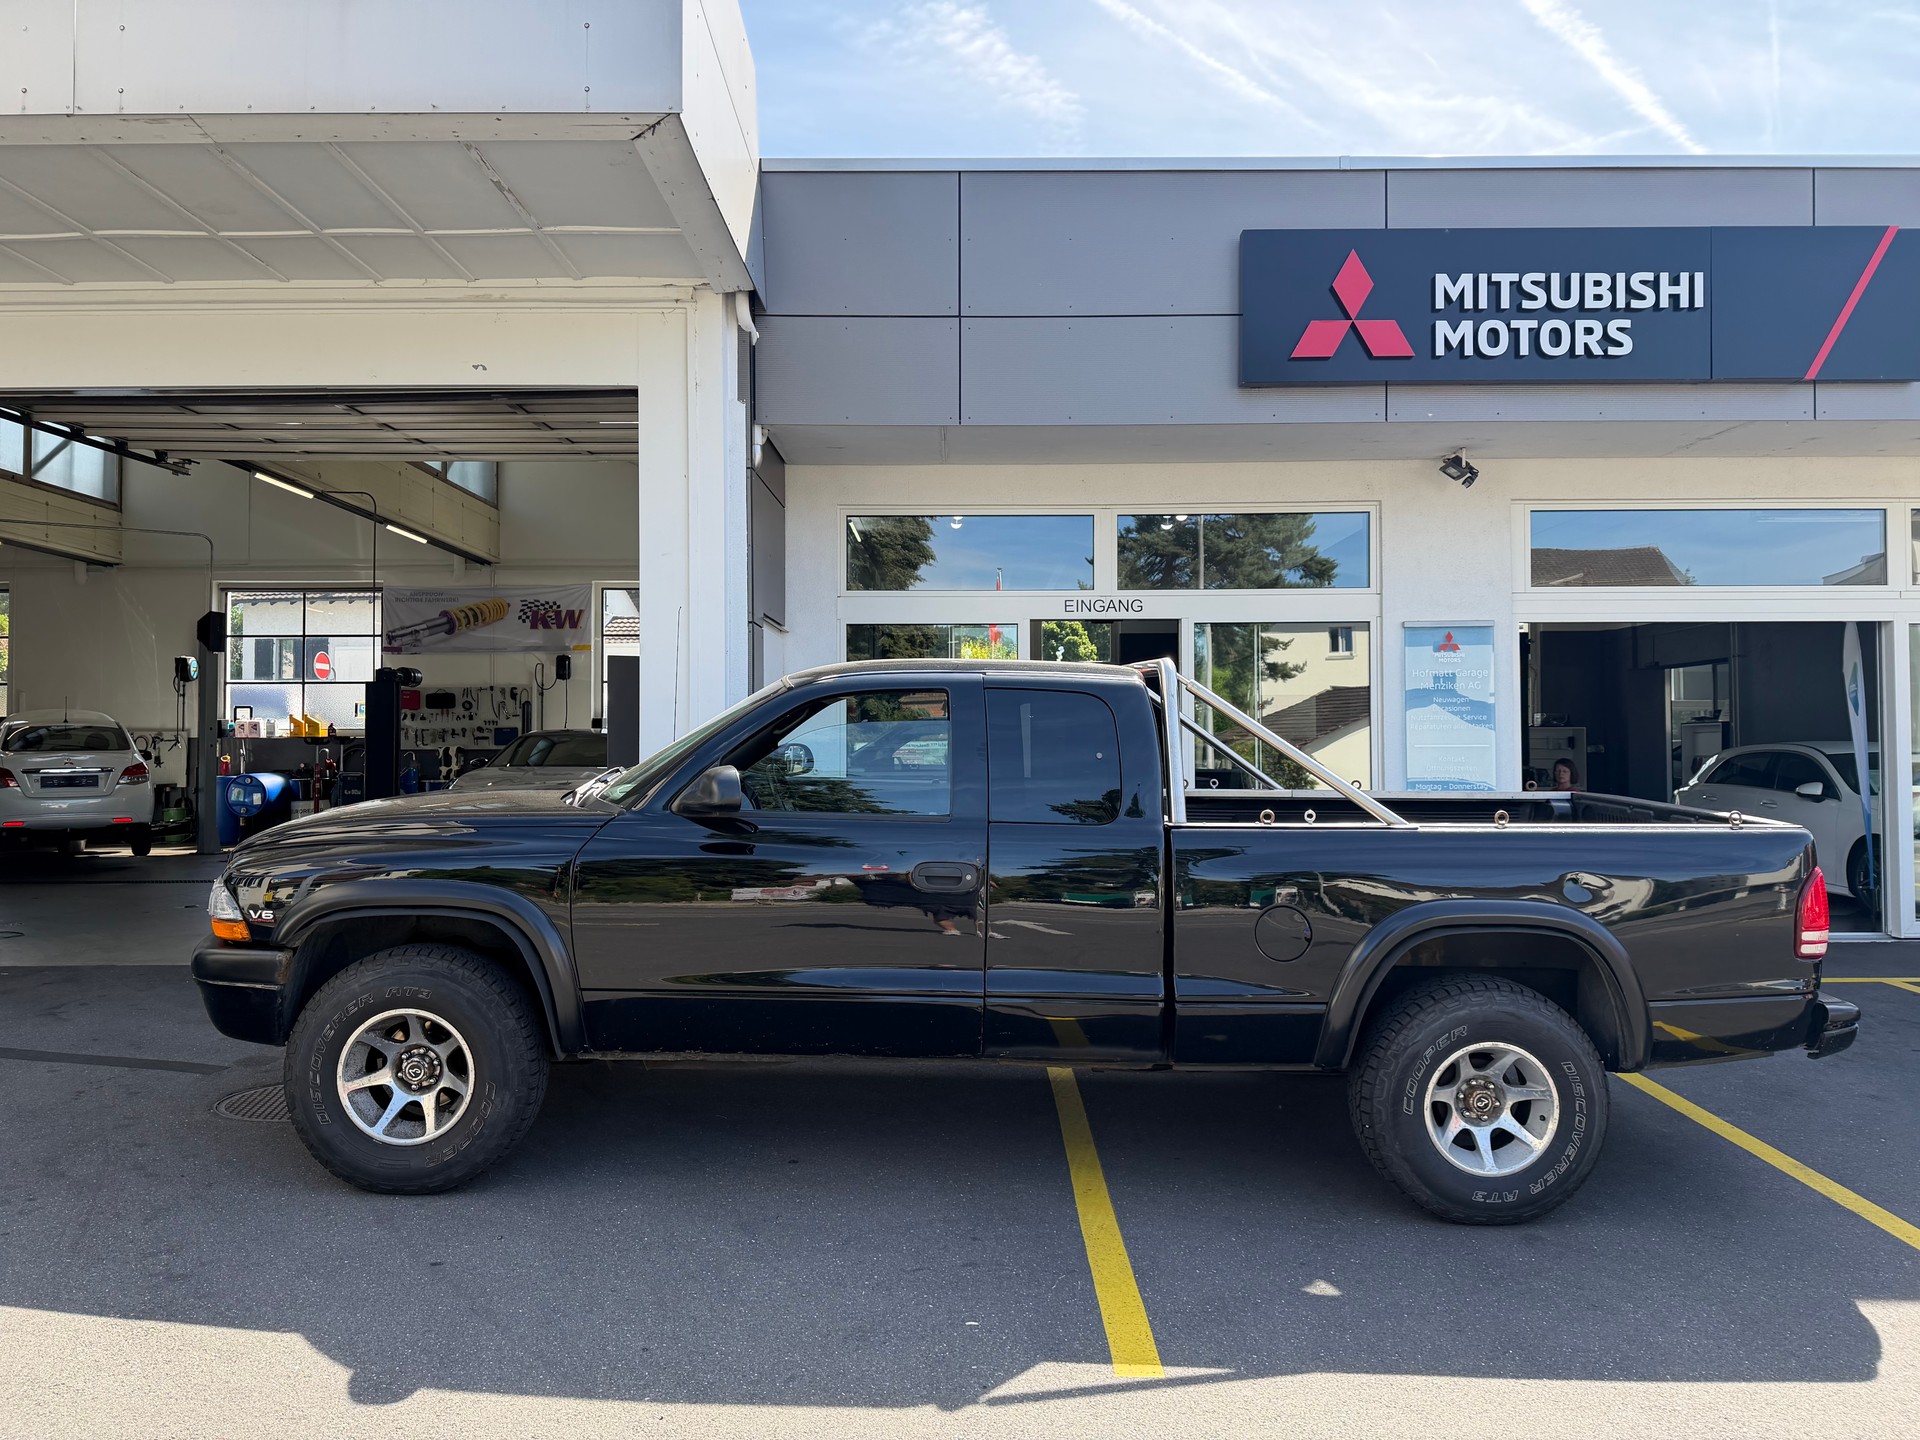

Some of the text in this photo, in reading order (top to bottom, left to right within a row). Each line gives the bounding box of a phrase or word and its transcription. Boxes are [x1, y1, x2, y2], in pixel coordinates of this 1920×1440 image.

[1434, 271, 1704, 310] MITSUBISHI
[1434, 318, 1634, 358] MOTORS
[1064, 599, 1144, 613] EINGANG
[529, 608, 585, 631] KW
[1412, 668, 1488, 679] Hofmatt Garage
[1420, 681, 1482, 690] Menziken AG
[1433, 696, 1469, 705] Neuwagen
[1463, 713, 1488, 721] Service
[1415, 783, 1442, 792] Montag
[1449, 783, 1489, 791] Donnerstag
[248, 909, 275, 920] V6
[308, 986, 433, 1126] DISCOVERER AT3
[1402, 1025, 1468, 1116] COOPER
[424, 1080, 497, 1169] COOPER
[1471, 1060, 1588, 1203] DISCOVERER AT3
